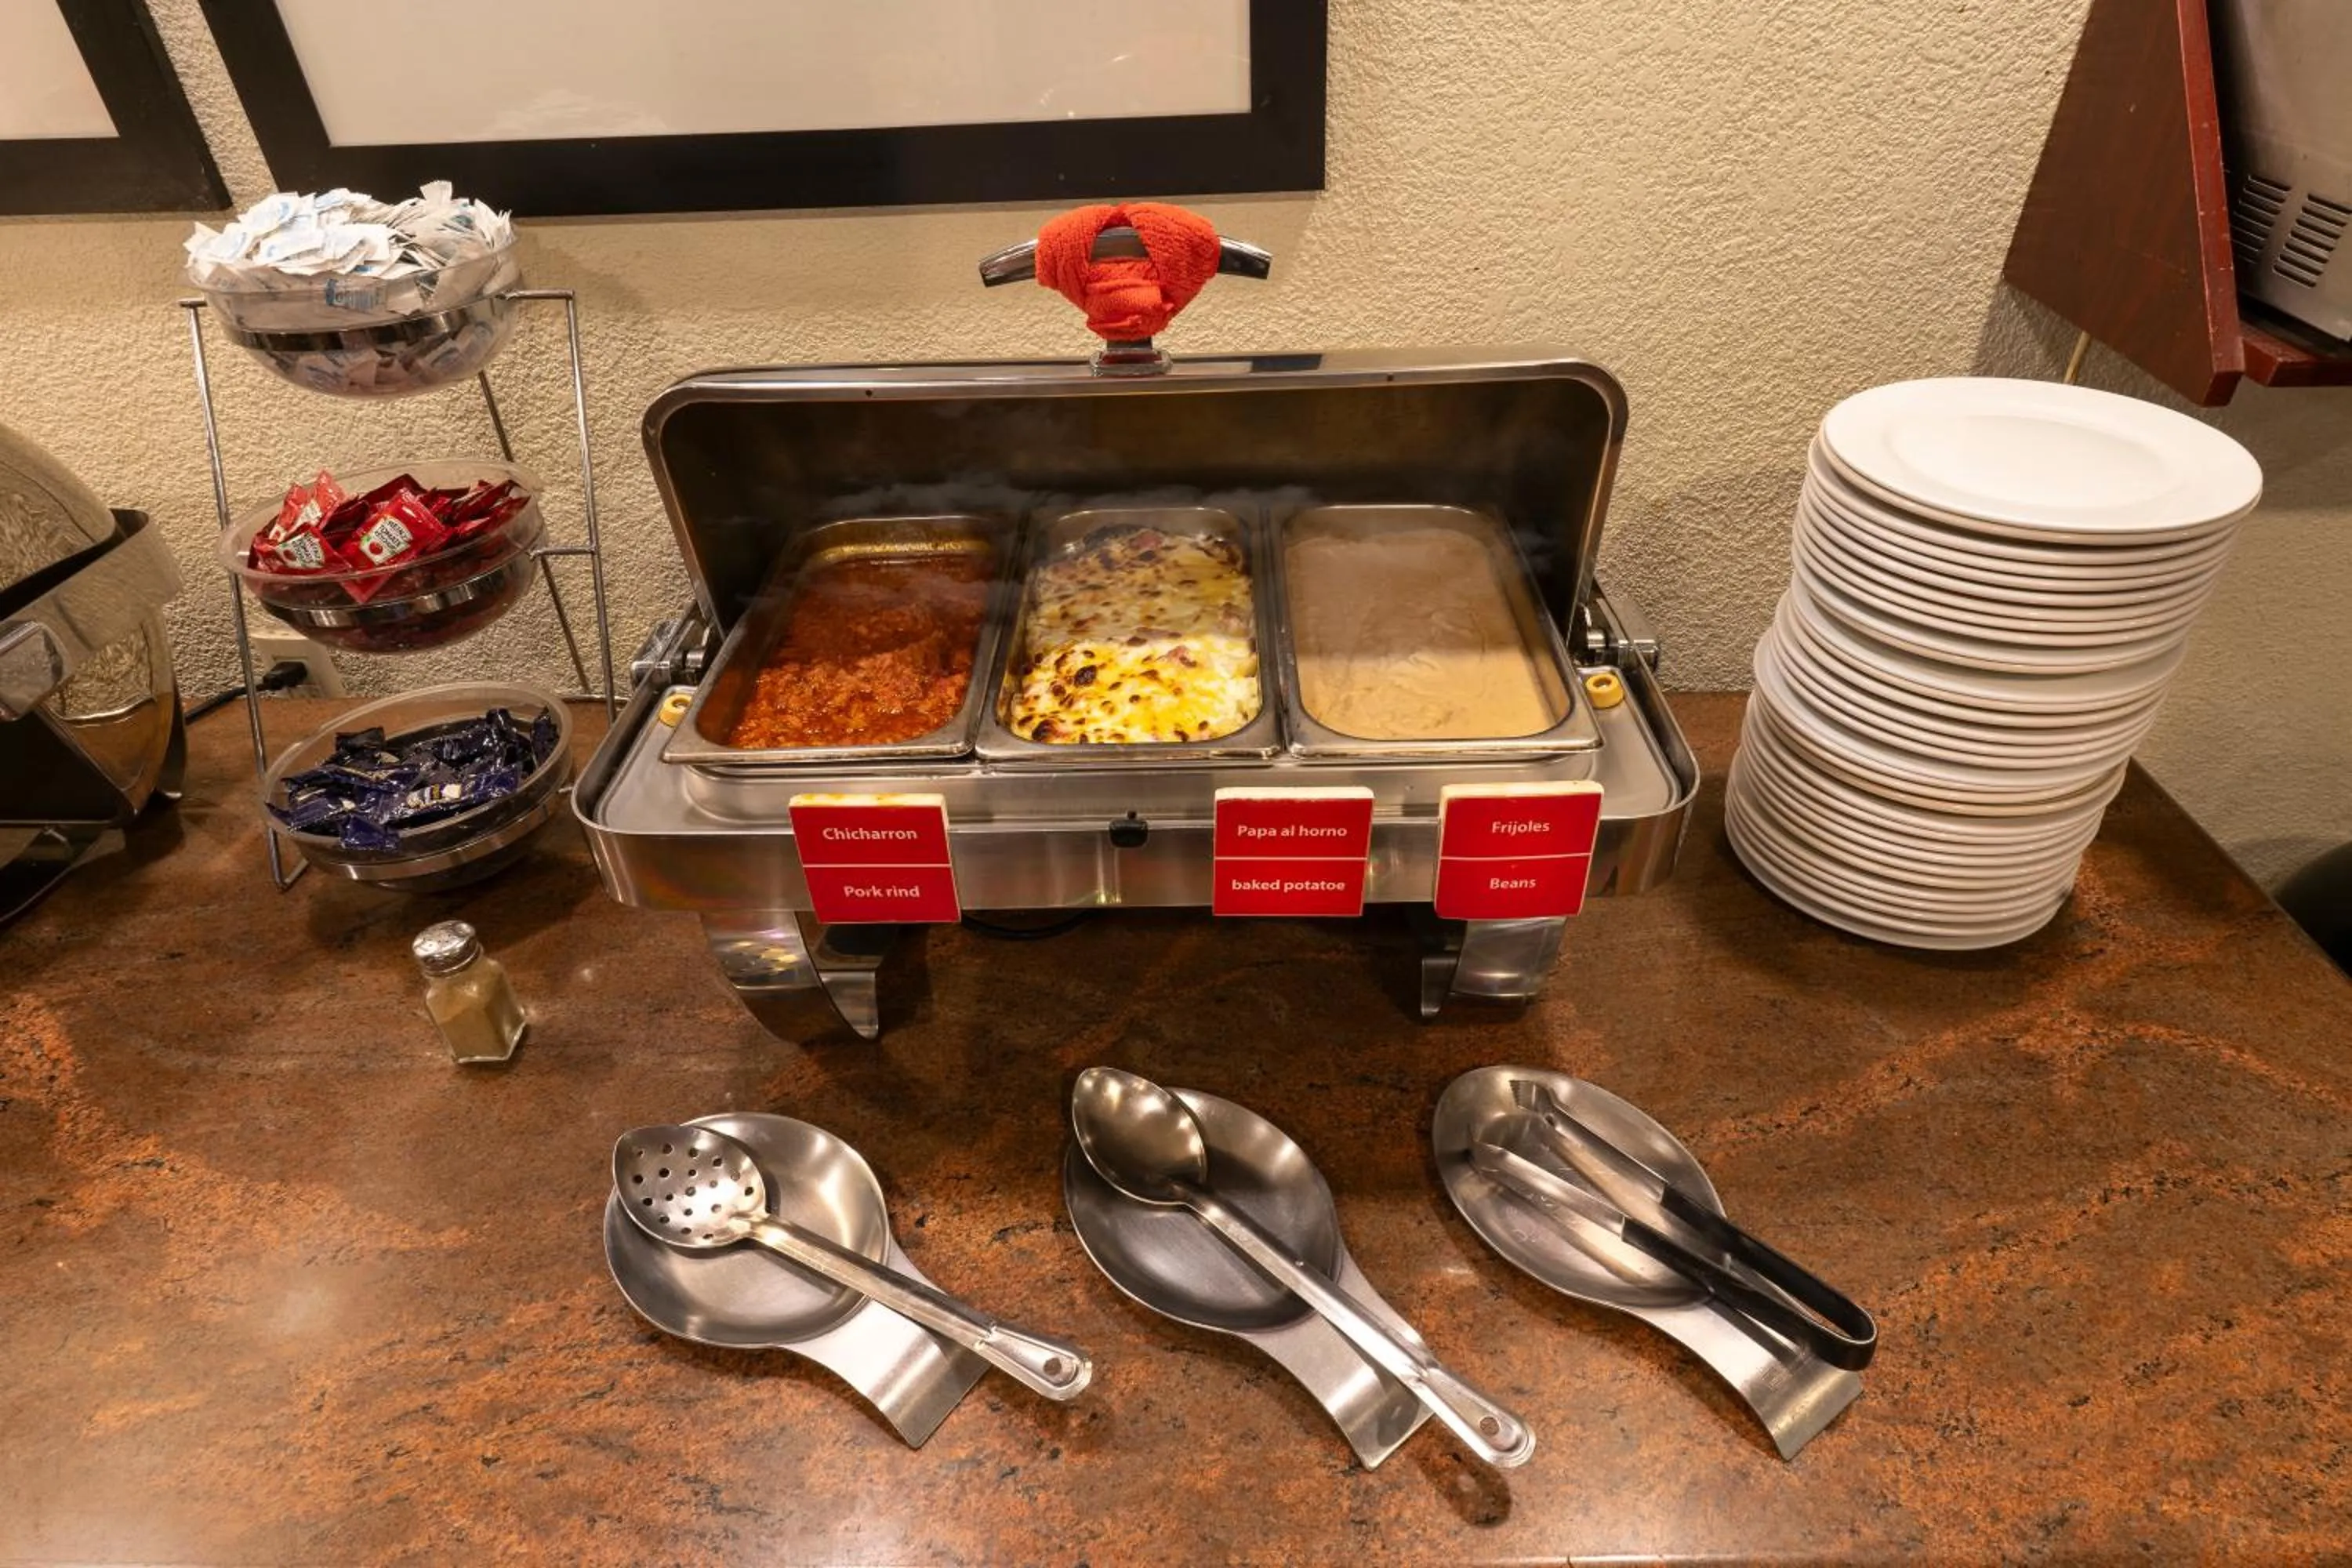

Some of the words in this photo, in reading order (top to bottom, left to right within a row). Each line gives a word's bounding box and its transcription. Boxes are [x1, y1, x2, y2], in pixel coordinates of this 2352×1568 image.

[822, 827, 917, 840] Chicharron
[1237, 825, 1277, 839] Papa
[1280, 825, 1295, 837] al
[1298, 825, 1348, 837] horno
[1492, 820, 1550, 836] Frijoles
[1232, 879, 1280, 891] baked
[1283, 880, 1345, 893] potatoe
[1490, 877, 1536, 890] Beans
[844, 885, 882, 898] Pork
[886, 885, 920, 898] rind
